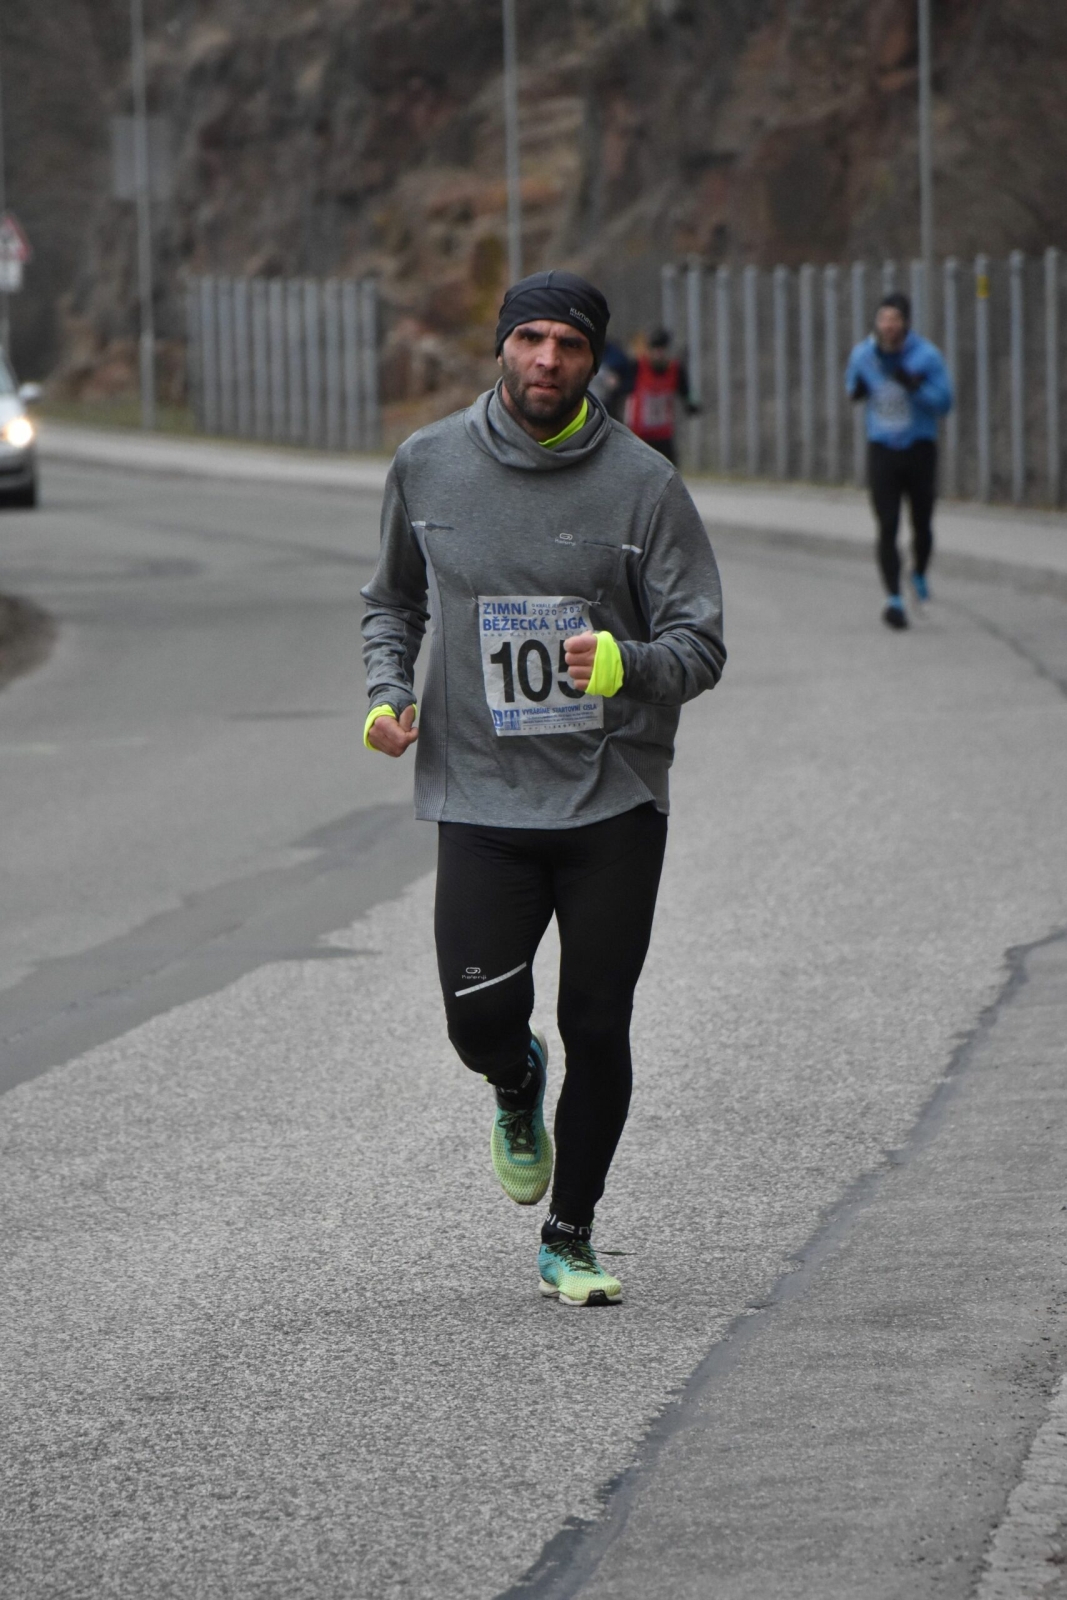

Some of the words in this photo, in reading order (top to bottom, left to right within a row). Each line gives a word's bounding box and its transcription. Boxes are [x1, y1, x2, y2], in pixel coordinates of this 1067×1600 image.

[482, 600, 527, 615] ZIMNÍ
[482, 616, 549, 631] BĚŽECKÁ
[555, 616, 587, 631] LIGA
